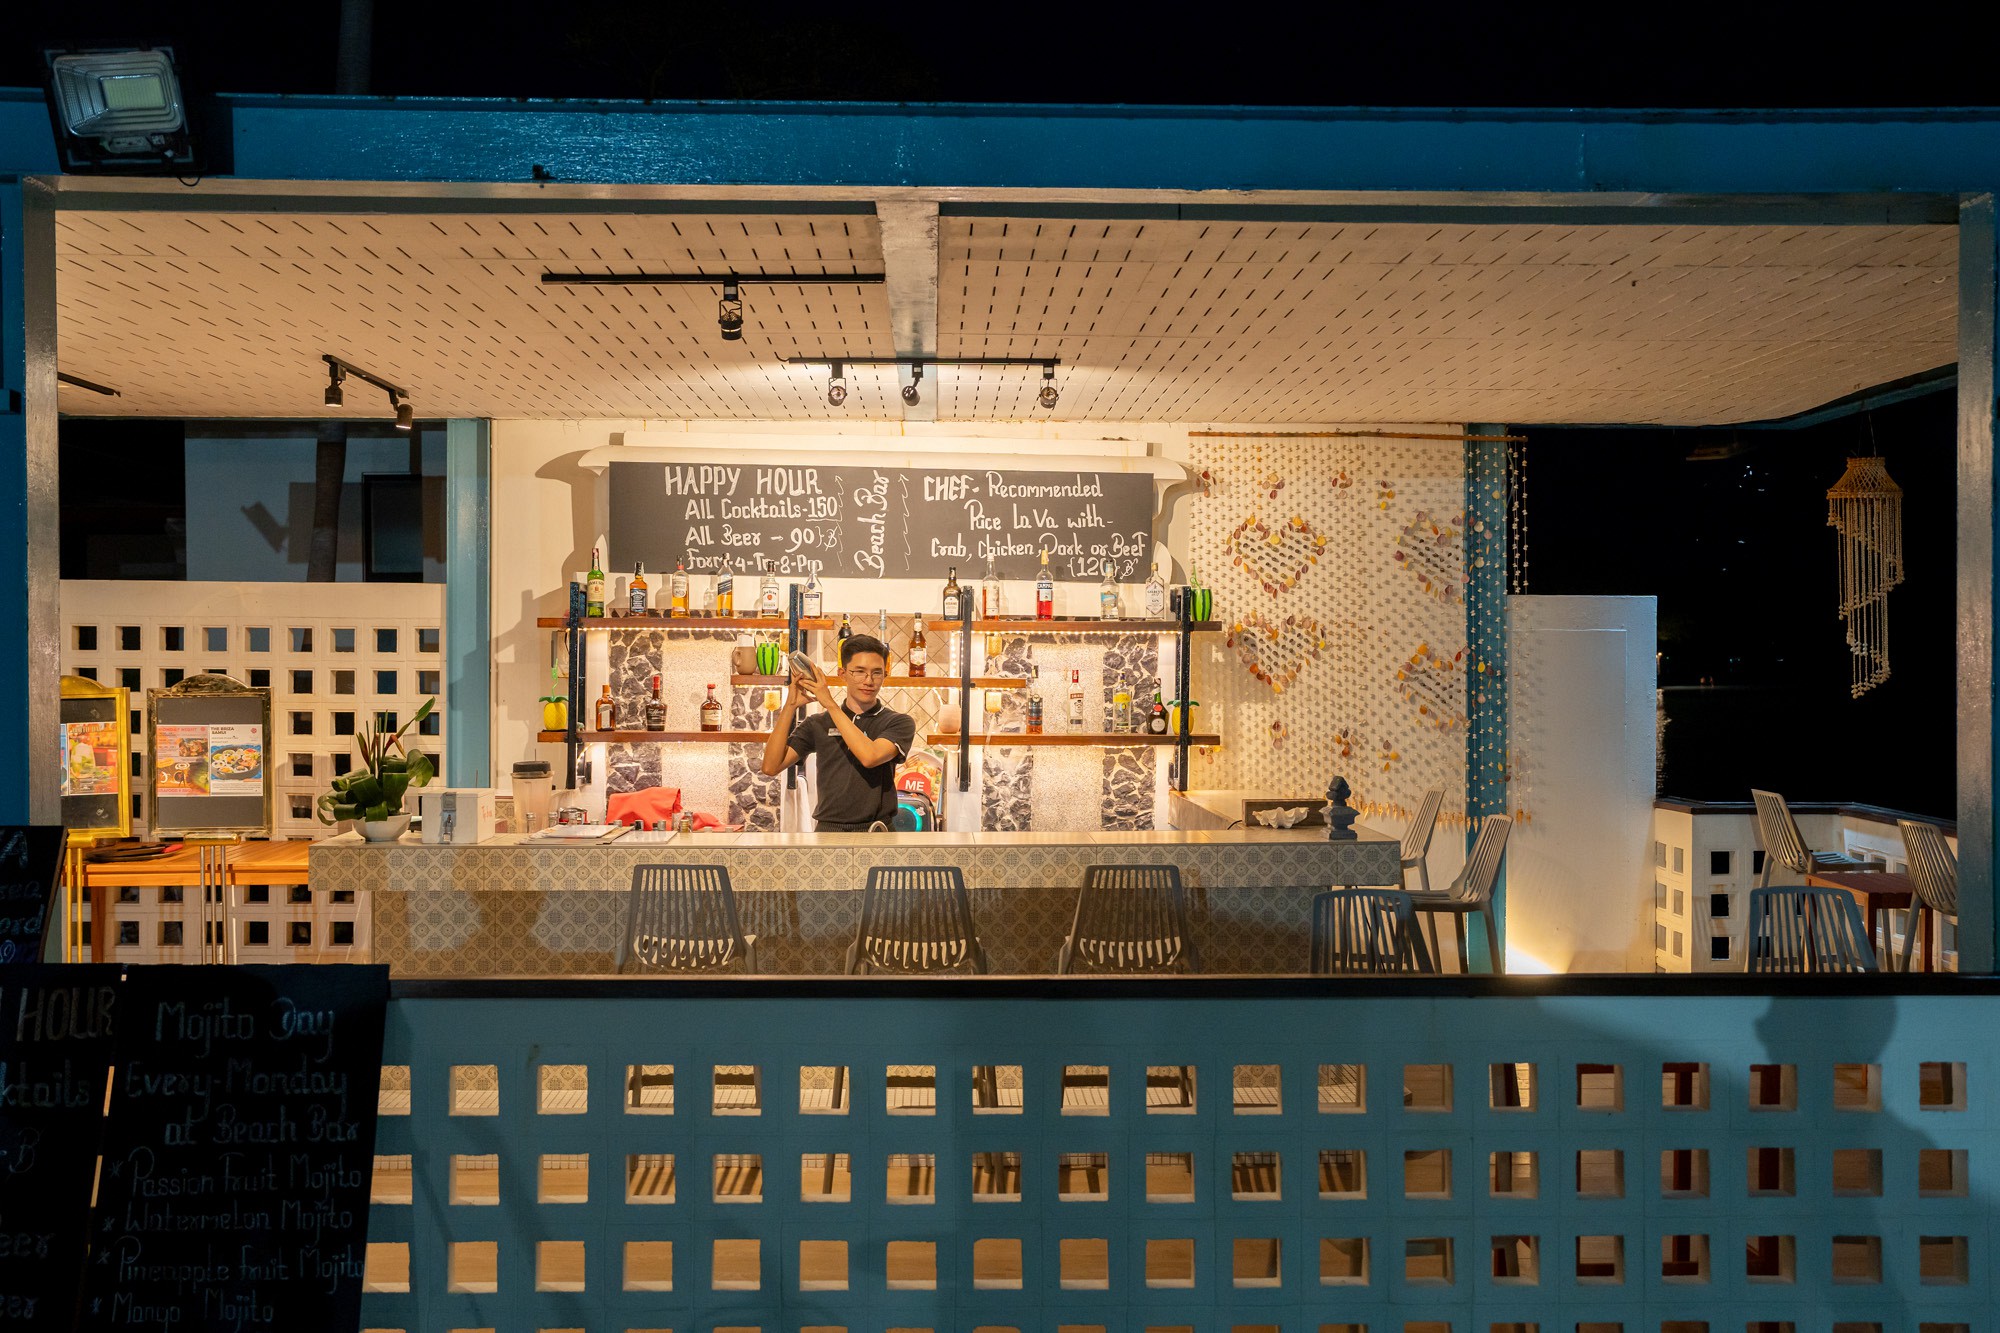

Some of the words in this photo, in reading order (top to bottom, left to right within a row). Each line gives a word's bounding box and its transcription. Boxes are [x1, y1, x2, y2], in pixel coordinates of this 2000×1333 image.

[664, 465, 741, 496] HAPPY
[756, 467, 822, 496] HOUR
[853, 469, 890, 513] Bar
[985, 470, 1104, 498] Recommended
[720, 523, 762, 547] Beer
[963, 499, 1002, 531] Rice
[853, 511, 887, 579] Beach
[1090, 543, 1109, 556] or
[905, 779, 925, 791] ME
[16, 985, 117, 1043] HOUR
[154, 996, 256, 1060] Mojito
[268, 996, 336, 1064] Day
[164, 1104, 199, 1146] at
[210, 1103, 298, 1146] Beach
[305, 1103, 361, 1144] Bar
[127, 1145, 215, 1198] Passion
[289, 1151, 363, 1205] Mojito
[124, 1202, 272, 1233] Watermelon
[280, 1199, 354, 1247] Mojito
[113, 1234, 231, 1296] Pineapple
[298, 1246, 365, 1296] Mojito
[111, 1290, 182, 1333] Mango
[203, 1287, 276, 1333] Mojito
